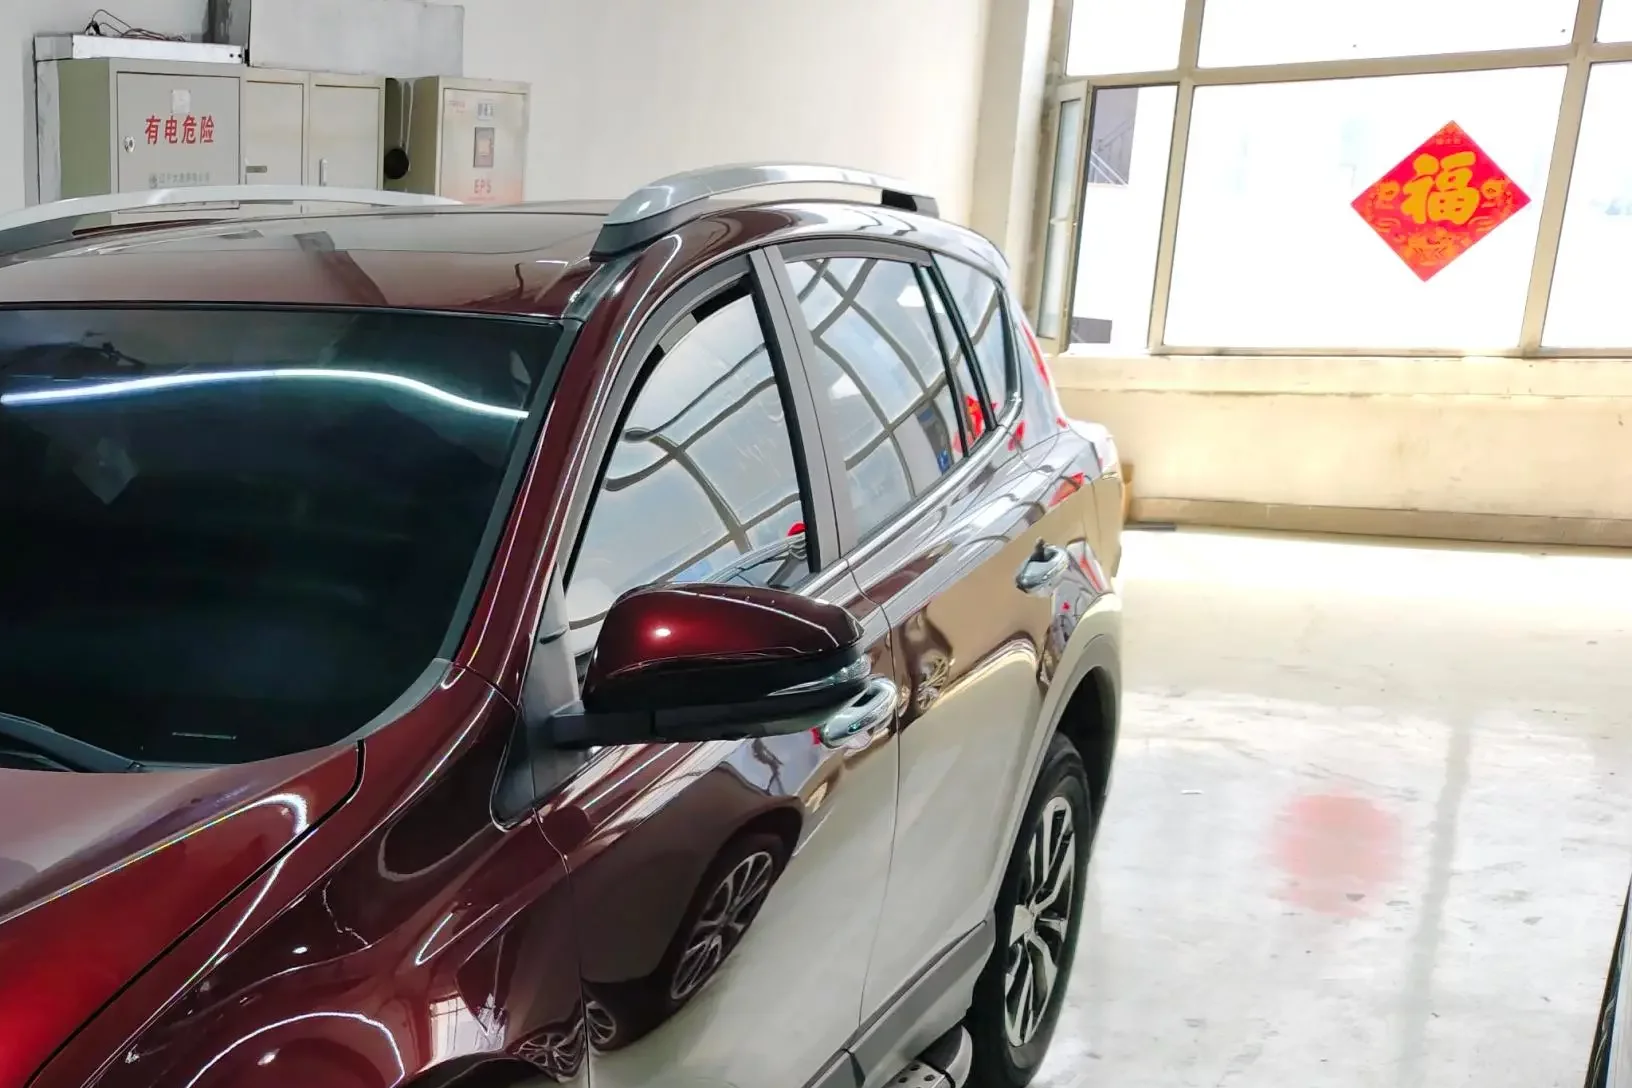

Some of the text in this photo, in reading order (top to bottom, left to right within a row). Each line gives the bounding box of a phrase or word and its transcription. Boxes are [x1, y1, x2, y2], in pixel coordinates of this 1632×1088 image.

[144, 114, 215, 145] 有电危险
[1400, 151, 1481, 225] 福
